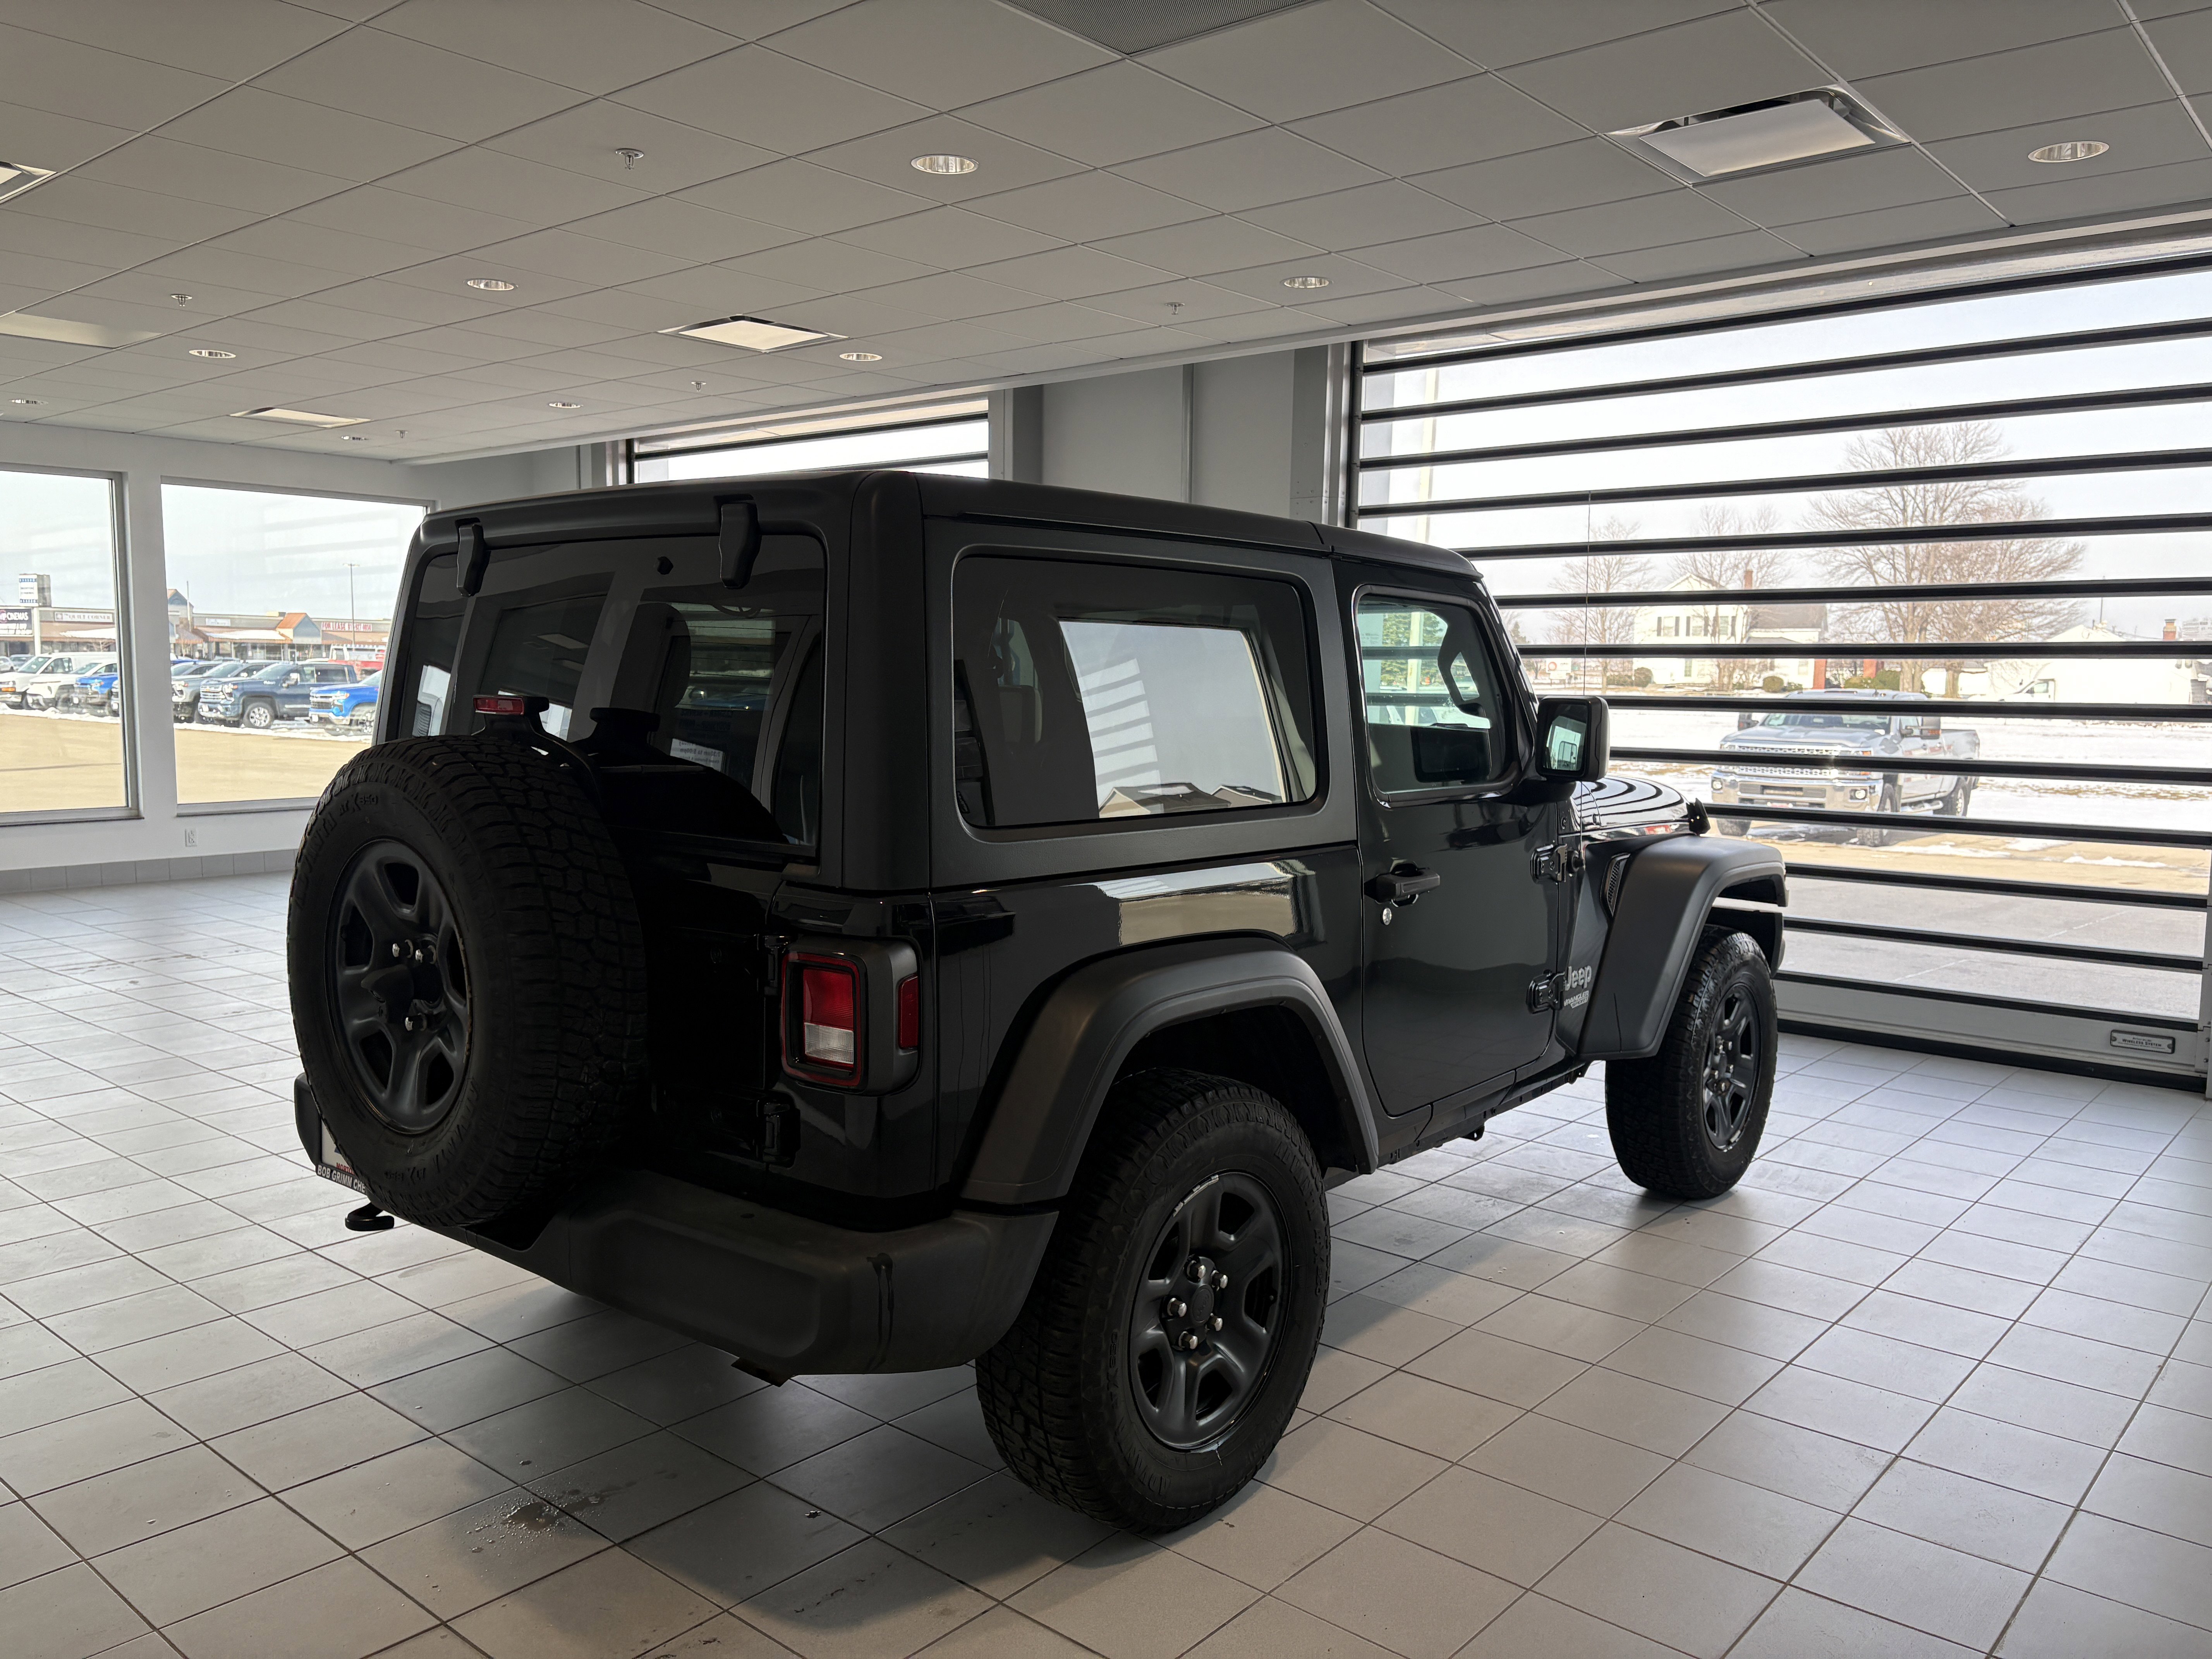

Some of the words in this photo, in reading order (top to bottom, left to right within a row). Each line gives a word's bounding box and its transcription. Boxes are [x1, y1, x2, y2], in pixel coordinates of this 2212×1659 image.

[7, 612, 28, 620] CINEMAS
[1565, 965, 1592, 991] Jeep
[1563, 990, 1589, 1007] WRANGLER
[318, 1165, 331, 1178] BOB
[332, 1170, 352, 1188] GRIMM
[353, 1179, 366, 1194] CHE
